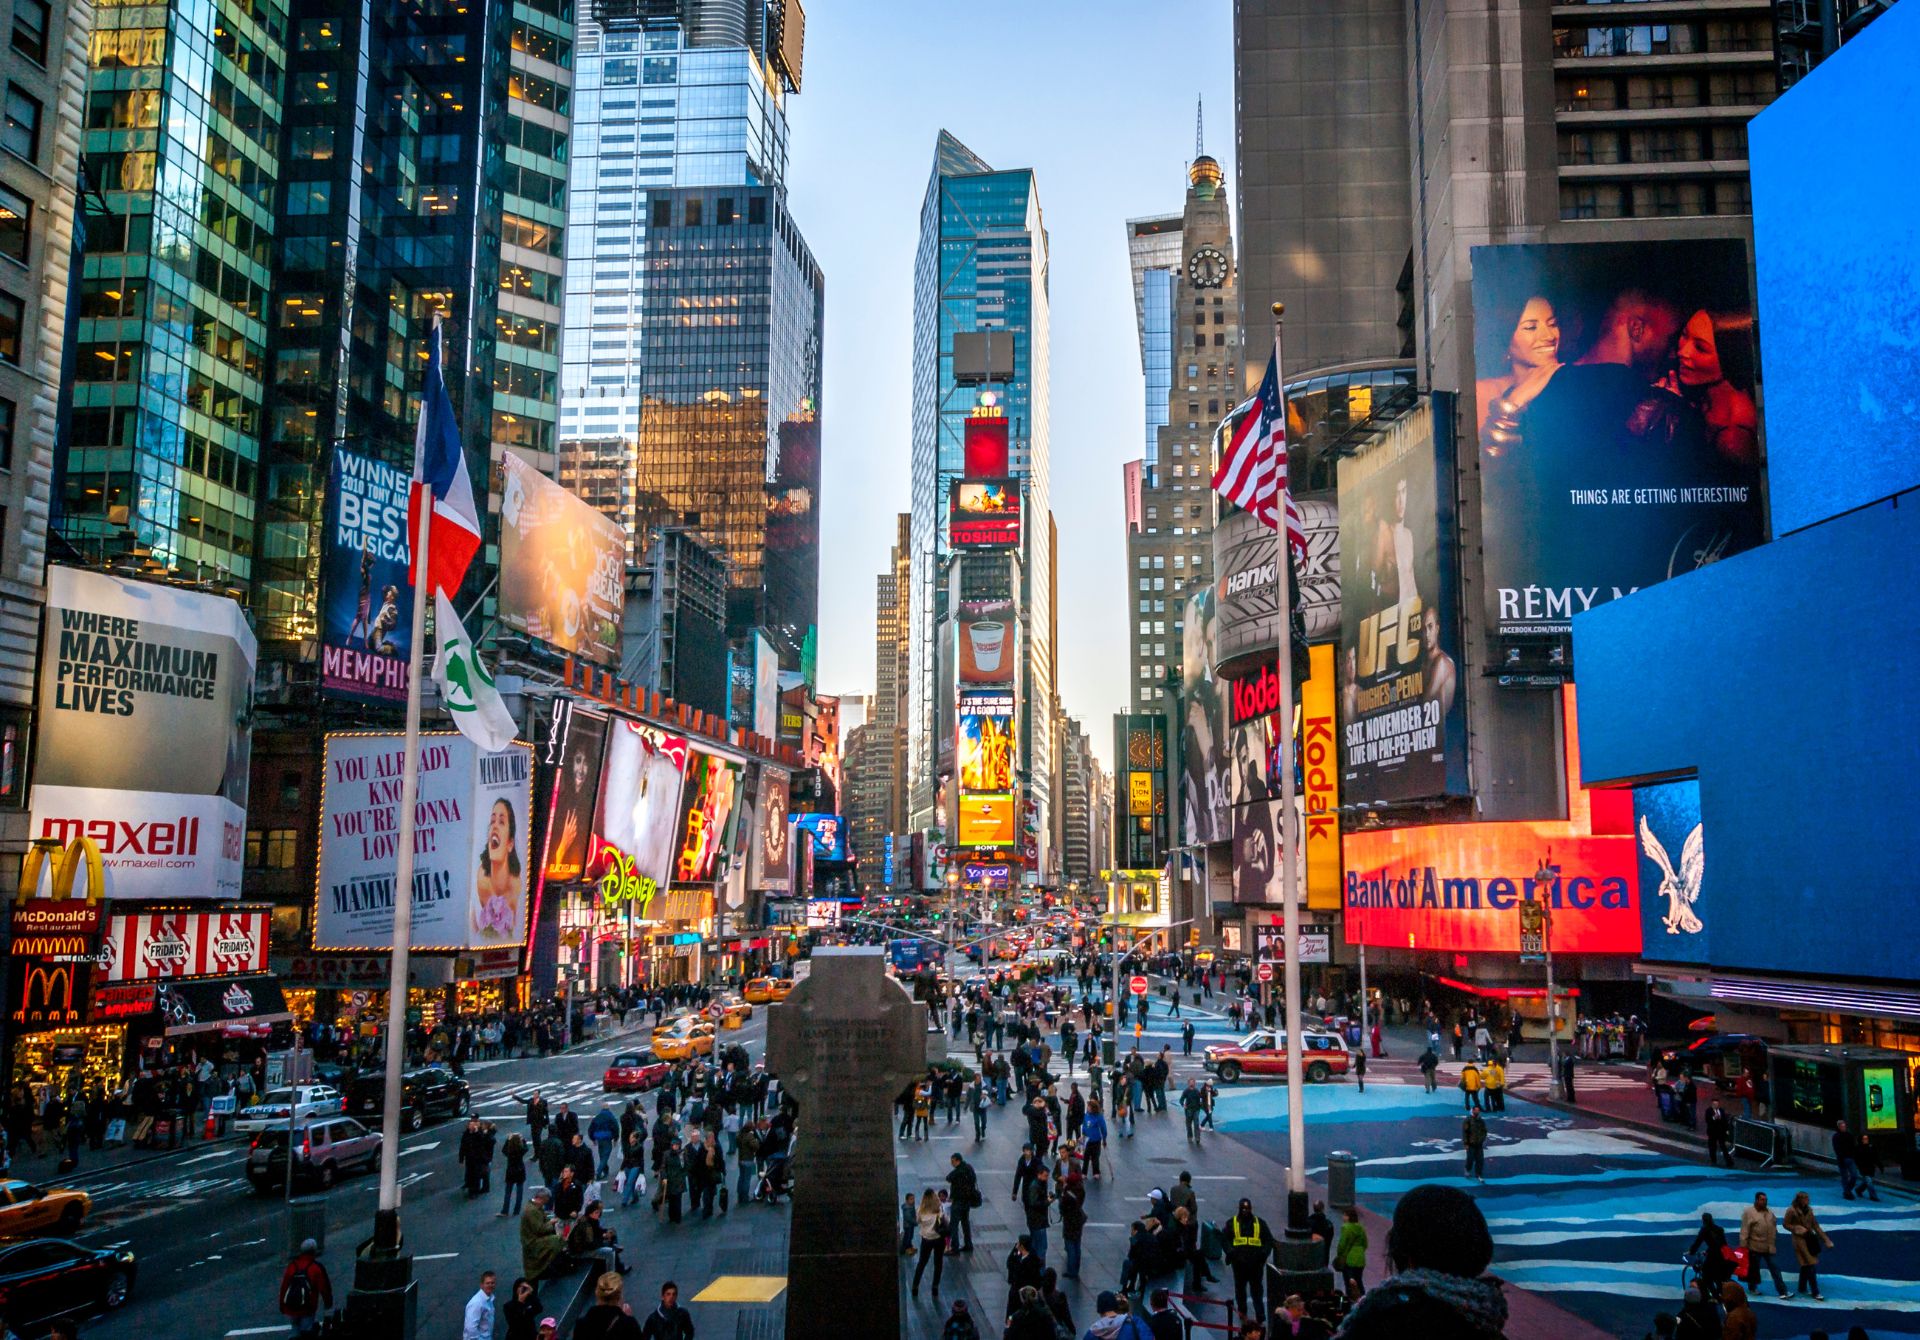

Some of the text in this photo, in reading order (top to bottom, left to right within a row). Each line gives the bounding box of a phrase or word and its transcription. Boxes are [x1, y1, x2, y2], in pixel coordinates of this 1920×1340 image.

[972, 406, 1002, 418] 2010
[341, 474, 364, 494] 2010
[368, 484, 390, 504] TONY
[1570, 487, 1748, 505] THINGS ARE GETTING INTERESTING
[952, 531, 1018, 543] TOSHIBA
[594, 546, 623, 582] YOGI
[592, 570, 624, 609] BEAR
[1497, 584, 1599, 620] RÉMY
[61, 608, 138, 639] WHERE
[1358, 594, 1422, 678] UFC
[1410, 614, 1421, 632] 123
[58, 630, 218, 680] MAXIMUM
[57, 662, 215, 700] PERFORMANCE
[1233, 666, 1280, 721] Koda
[1396, 671, 1424, 700] PENN
[55, 683, 135, 716] LIVES
[976, 706, 996, 715] GOOD
[1346, 721, 1366, 747] SAT.
[1366, 705, 1422, 742] NOVEMBER
[1424, 700, 1440, 726] 20
[1350, 743, 1366, 766] LIVE
[1366, 740, 1378, 762] ON
[1378, 726, 1436, 760] PAY-PER-VIEW
[334, 744, 452, 784] YOU ALRADY
[480, 754, 528, 784] MAMMA MIA!
[1302, 716, 1335, 841] Kodak
[1132, 788, 1149, 798] LION
[1132, 799, 1150, 810] KING
[332, 798, 461, 838] YOU'RE ONNA
[42, 816, 200, 856] maxell
[414, 828, 436, 854] IT!
[332, 877, 397, 914] MAMM
[1347, 864, 1630, 910] Bank of America
[14, 910, 96, 922] McDonald's
[26, 924, 82, 932] Restaurant
[1521, 934, 1542, 942] KING
[1521, 942, 1542, 951] TUT
[292, 958, 392, 972] DIGITA
